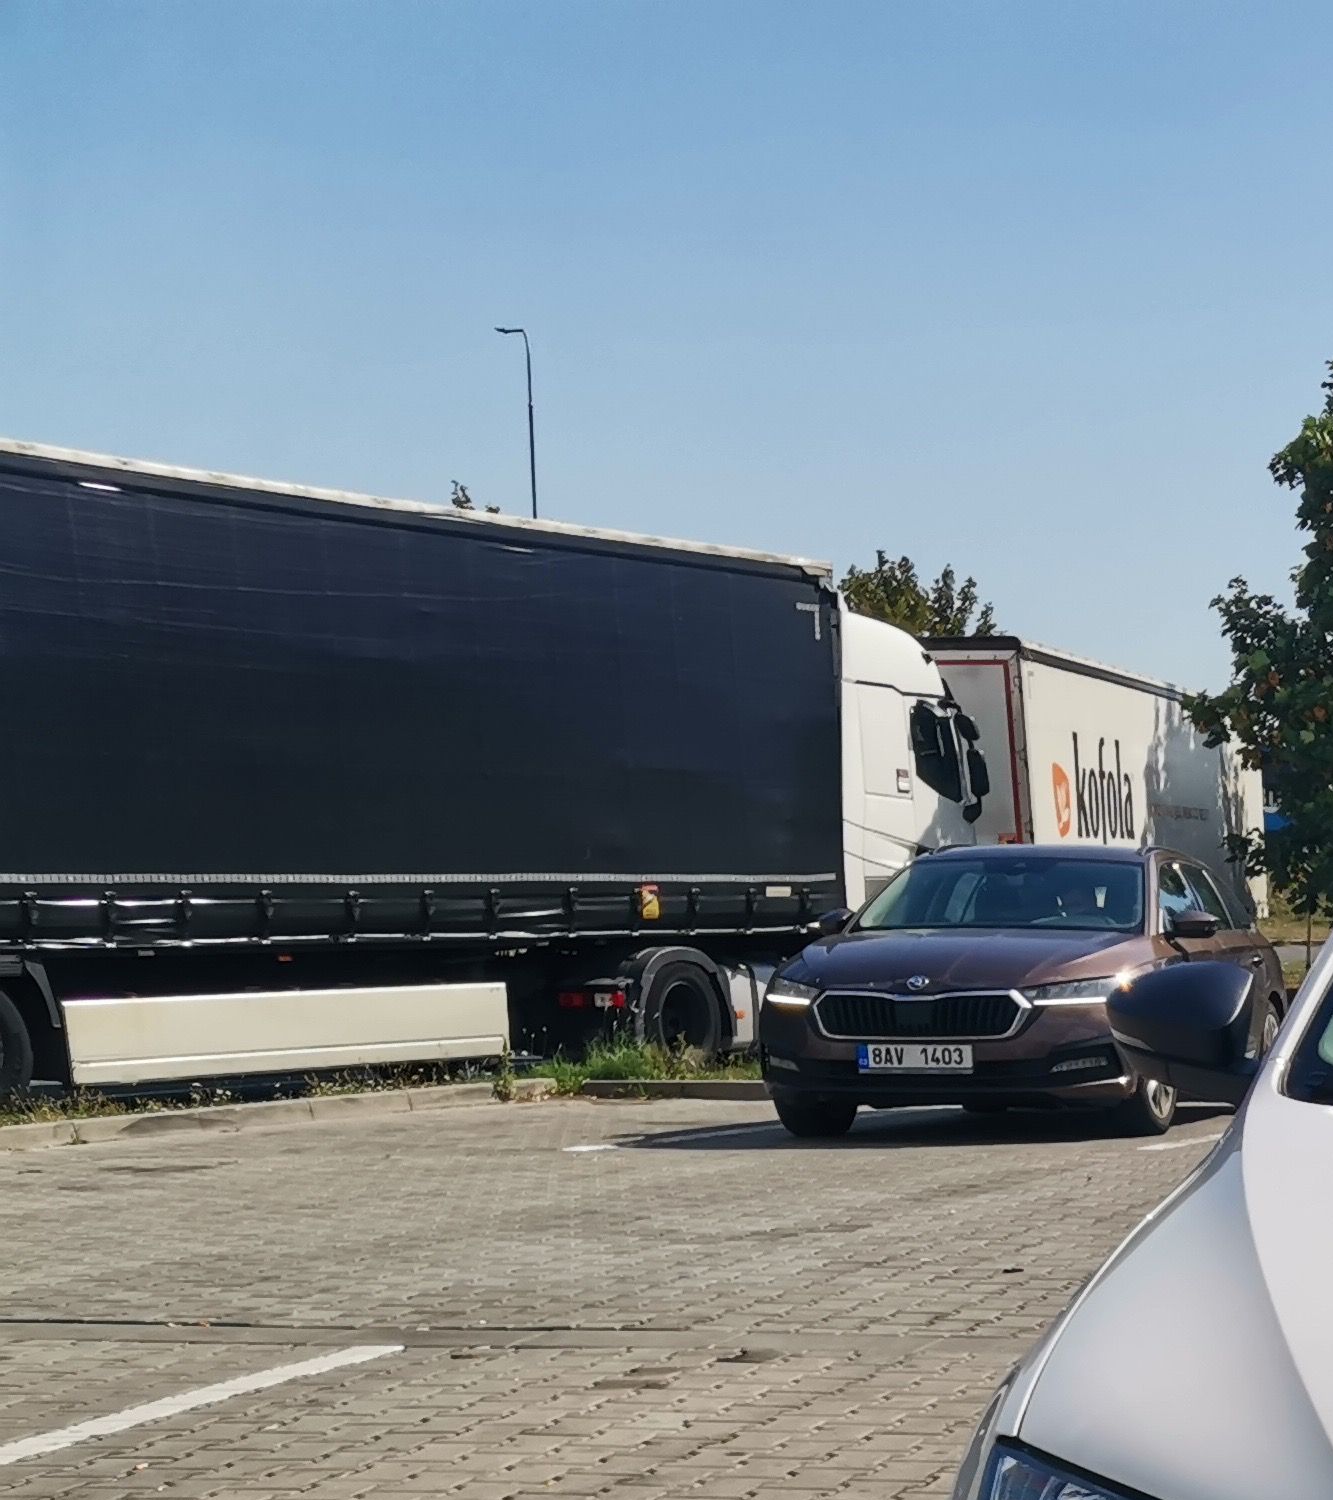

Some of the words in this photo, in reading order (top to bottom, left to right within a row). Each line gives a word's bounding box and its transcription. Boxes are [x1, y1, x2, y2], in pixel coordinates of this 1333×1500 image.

[1072, 731, 1135, 845] kofola
[872, 1047, 904, 1065] 8AV
[920, 1047, 964, 1065] 1403
